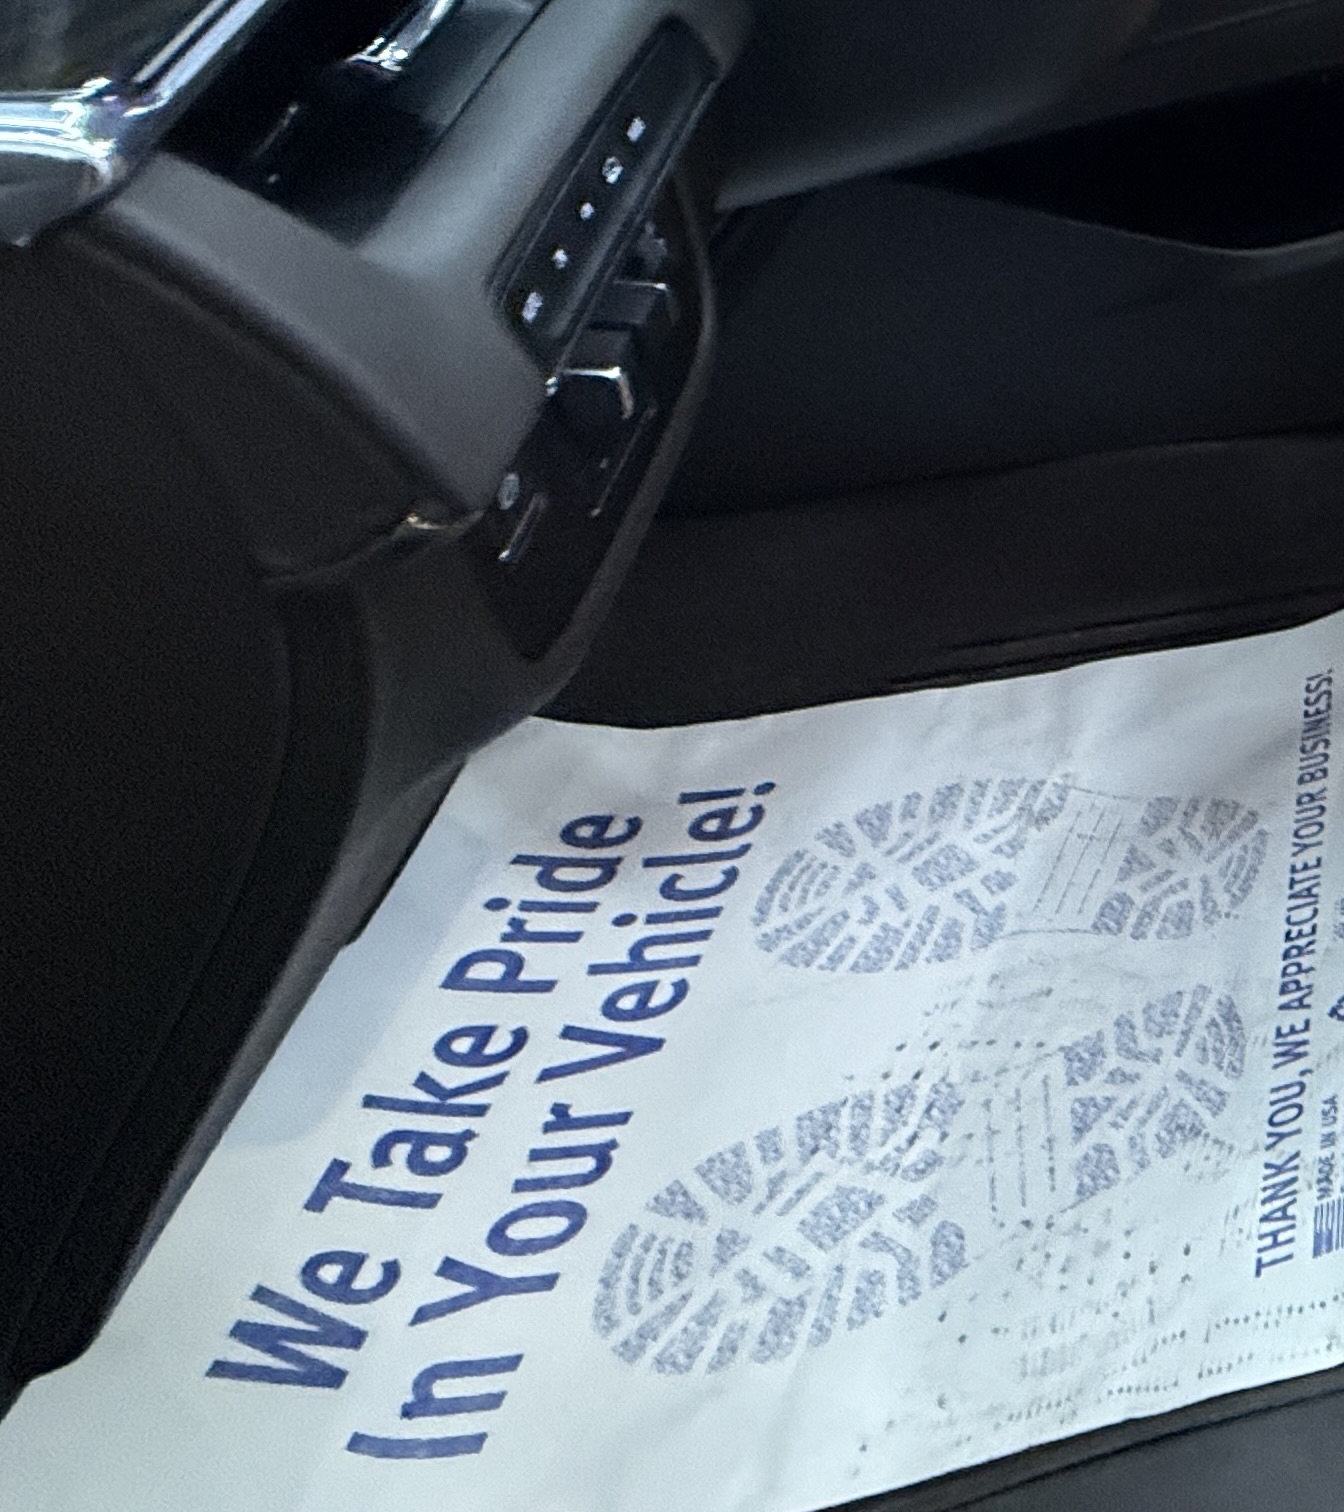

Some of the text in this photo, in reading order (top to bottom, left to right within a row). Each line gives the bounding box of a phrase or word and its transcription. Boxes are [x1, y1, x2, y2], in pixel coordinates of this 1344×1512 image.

[205, 813, 642, 1390] We Take Pride
[346, 780, 777, 1459] In Your Vehicle!
[1255, 667, 1334, 1278] THANK YOU, WE APPRECIATE YOUR BUSINESS!
[1316, 1094, 1338, 1201] MADE IN USA
